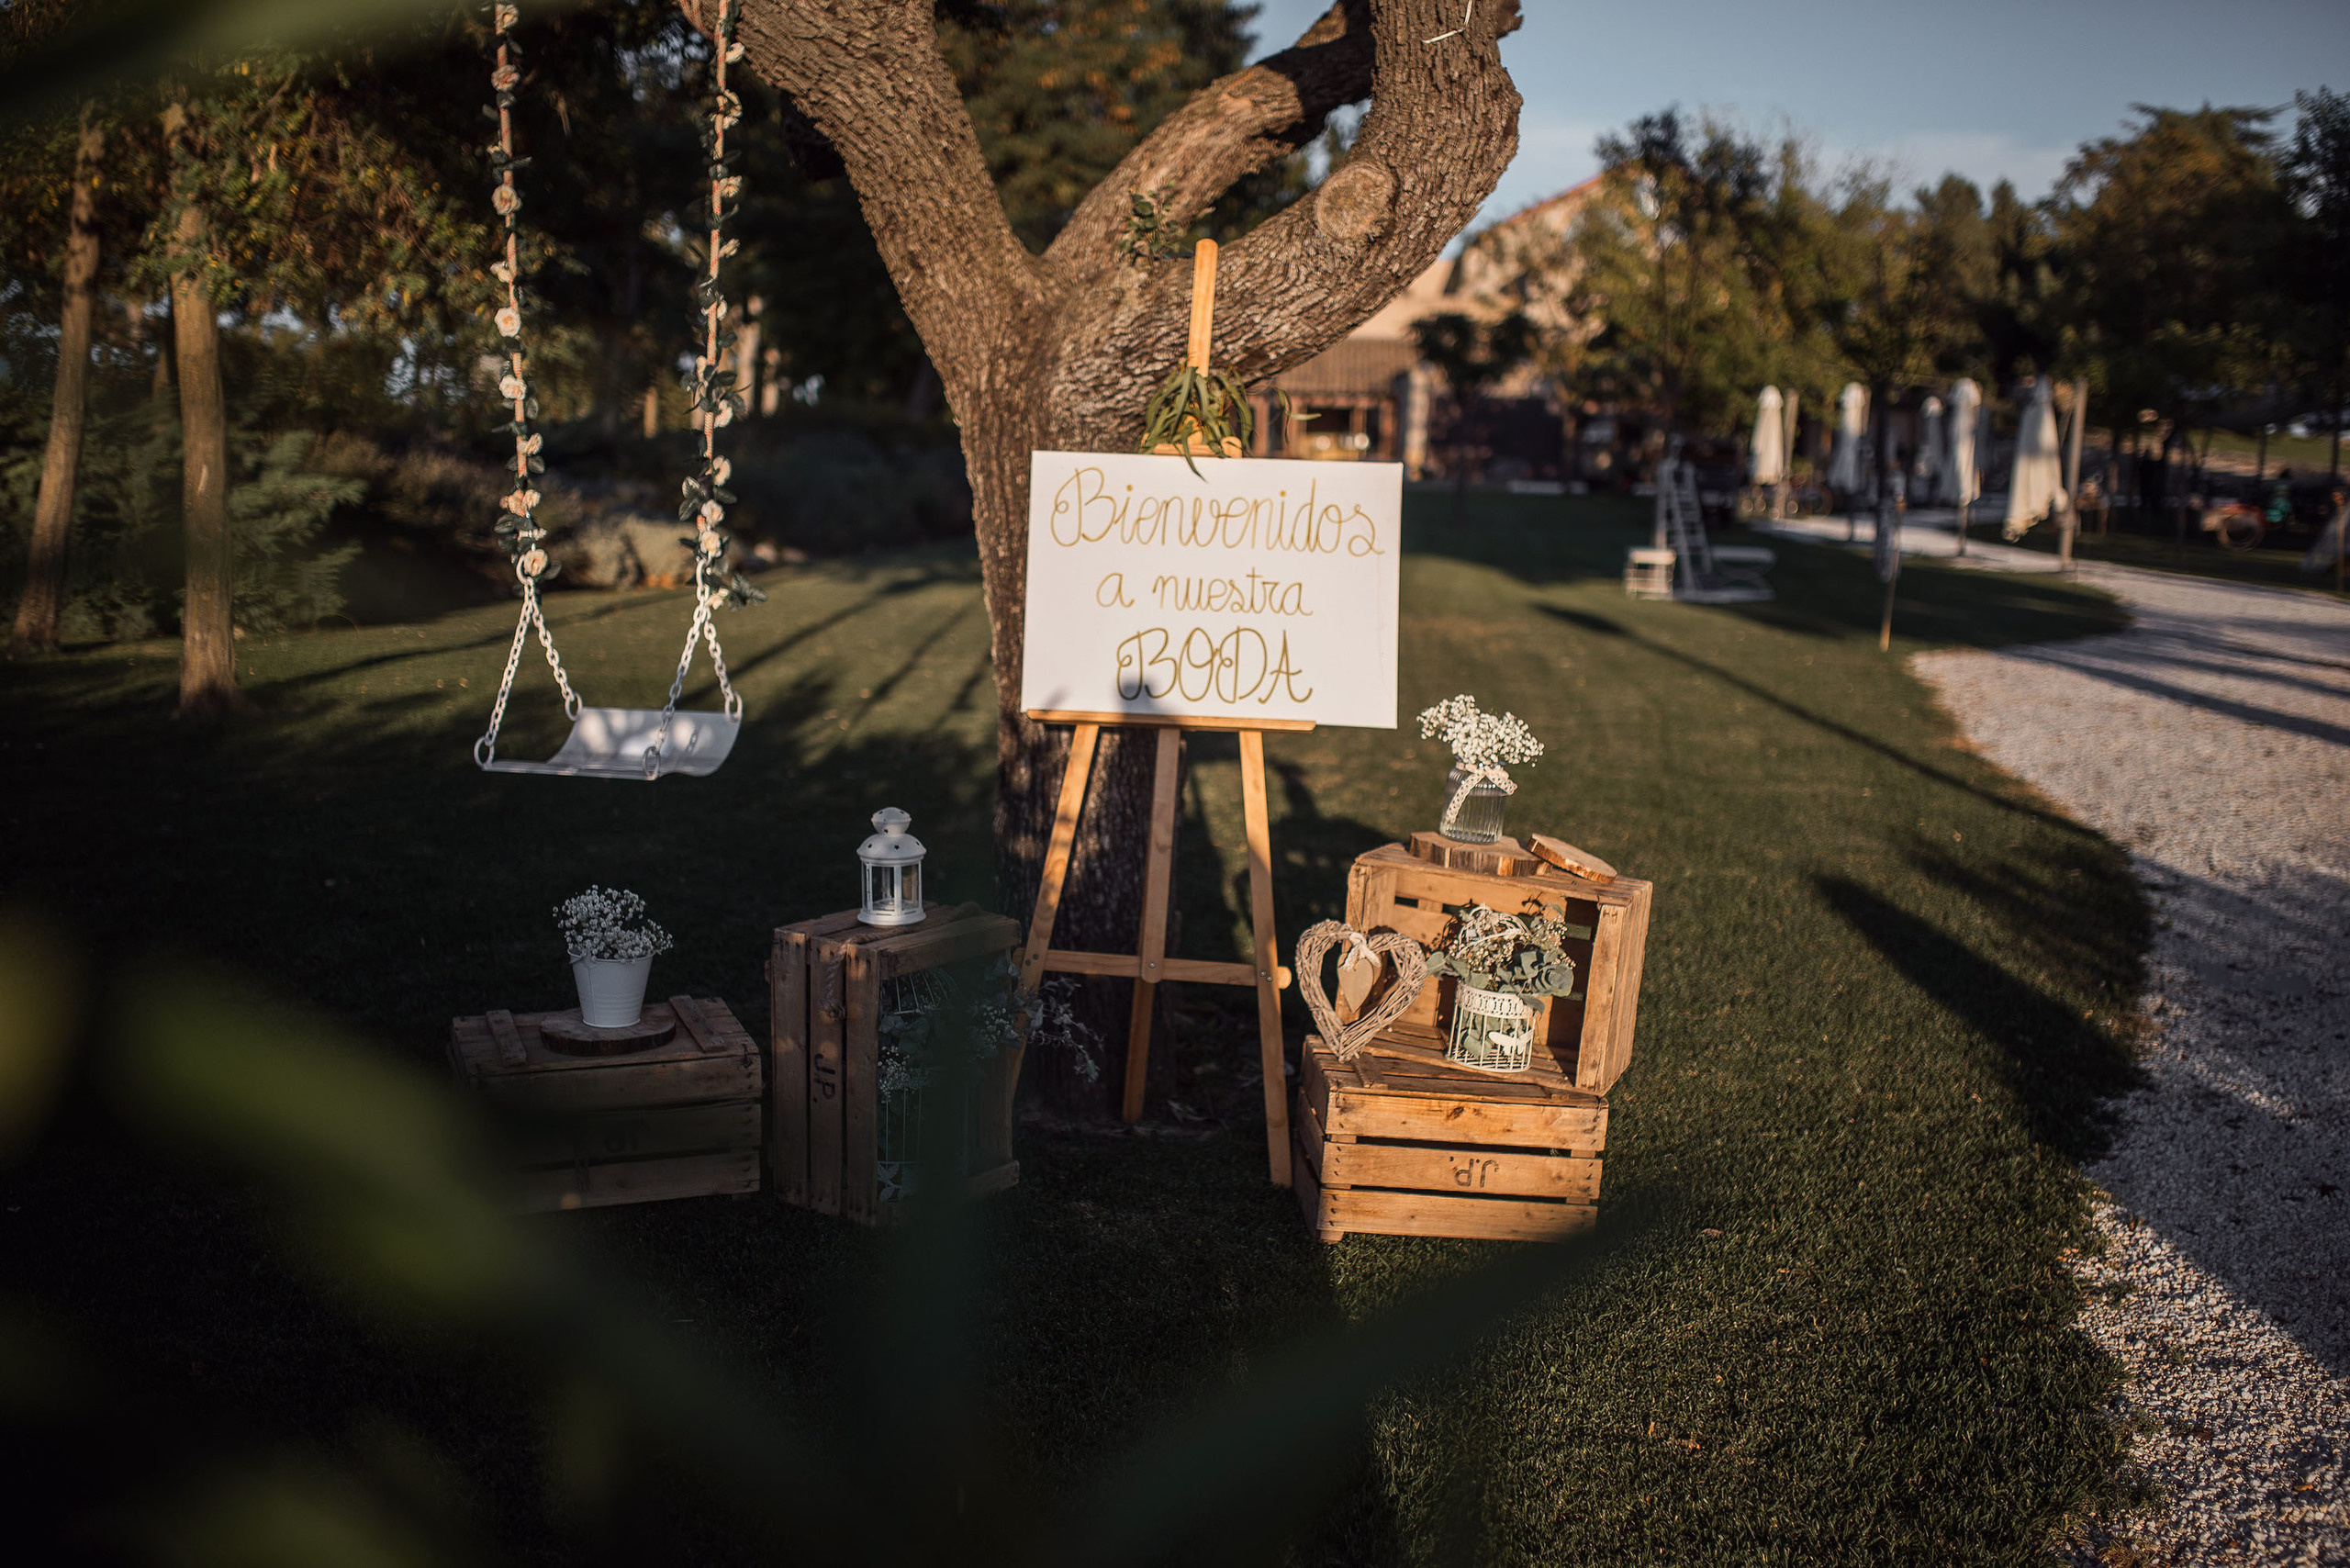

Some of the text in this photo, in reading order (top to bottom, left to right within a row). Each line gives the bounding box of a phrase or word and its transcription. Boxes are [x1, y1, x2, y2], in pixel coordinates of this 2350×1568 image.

[1049, 465, 1386, 557] Bienvenidos
[1095, 566, 1315, 617] a nuestra
[1115, 625, 1314, 704] BODA
